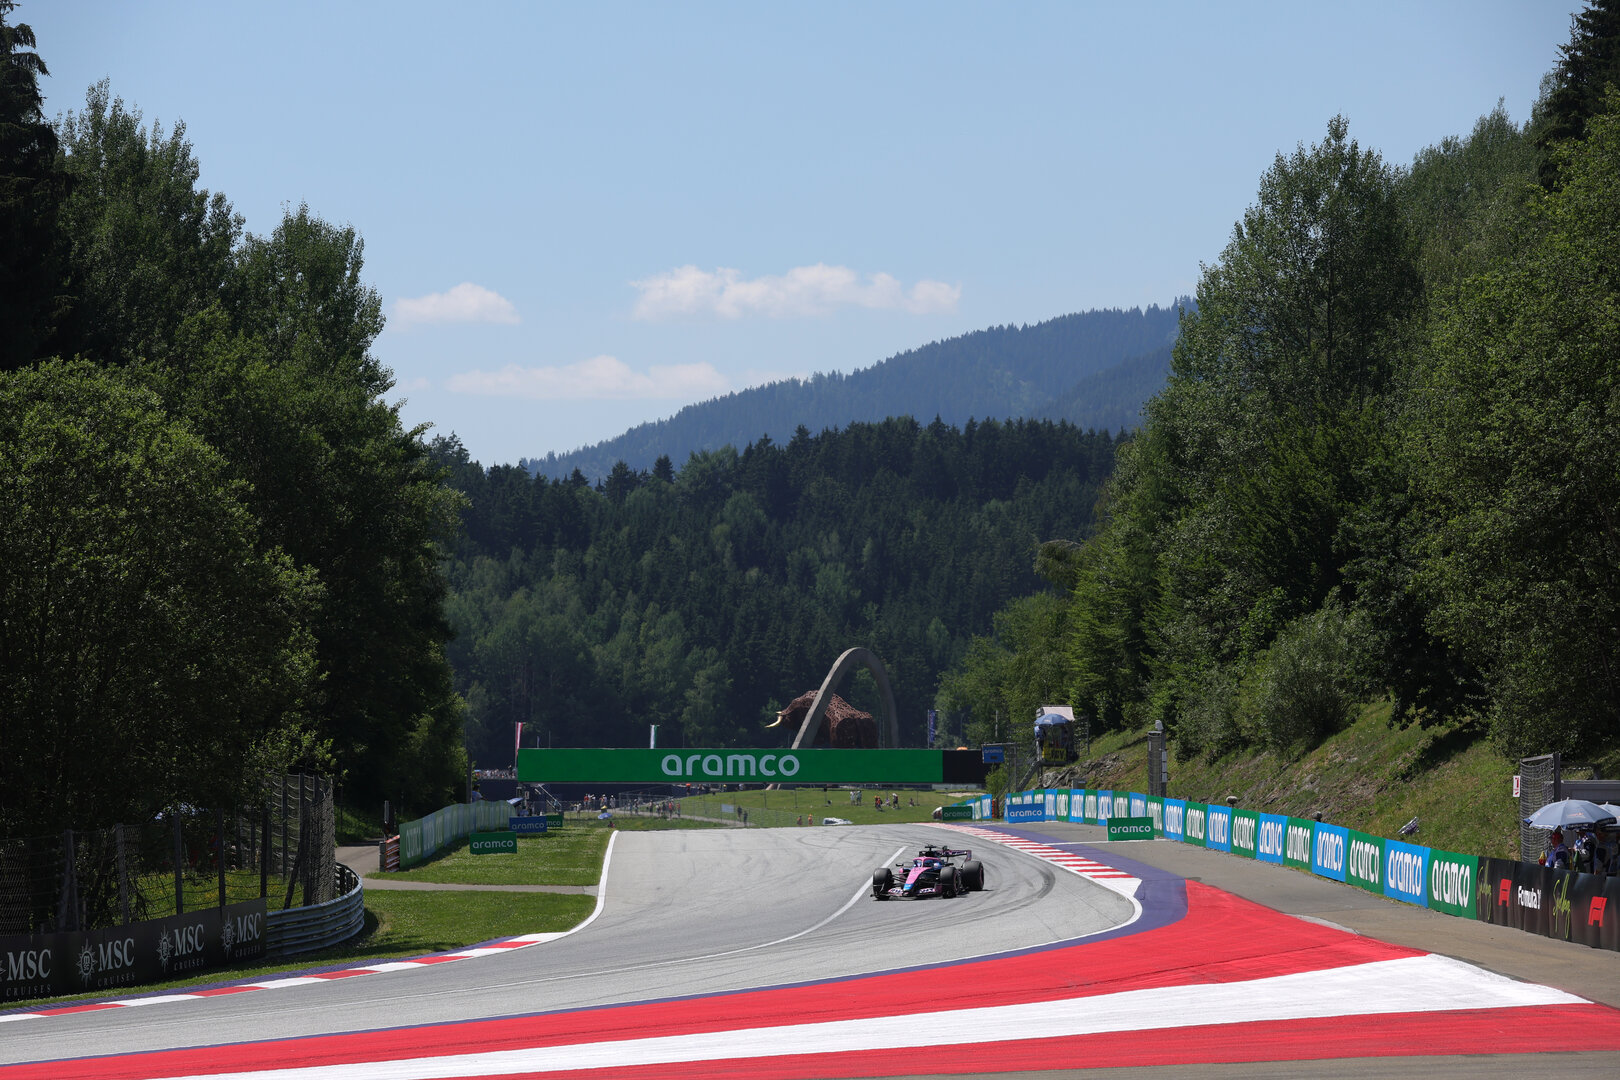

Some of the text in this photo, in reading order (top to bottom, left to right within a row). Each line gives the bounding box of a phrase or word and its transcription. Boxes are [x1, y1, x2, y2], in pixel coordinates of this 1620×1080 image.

[661, 754, 800, 776] aramco
[511, 822, 545, 830] aramco
[1009, 809, 1043, 817] aramco
[472, 840, 514, 849] aramco
[1110, 825, 1151, 834] aramco
[1286, 825, 1311, 863] aramco
[1317, 831, 1344, 872] aramco
[1350, 839, 1380, 884] aramco
[1388, 850, 1423, 896] aramco
[1432, 860, 1470, 908] aramco
[174, 924, 205, 957] MSC
[236, 912, 262, 944] MSC
[7, 949, 52, 981] MSC
[98, 938, 135, 972] MSC
[6, 984, 51, 997] CRUISES
[97, 972, 135, 987] CRUISES
